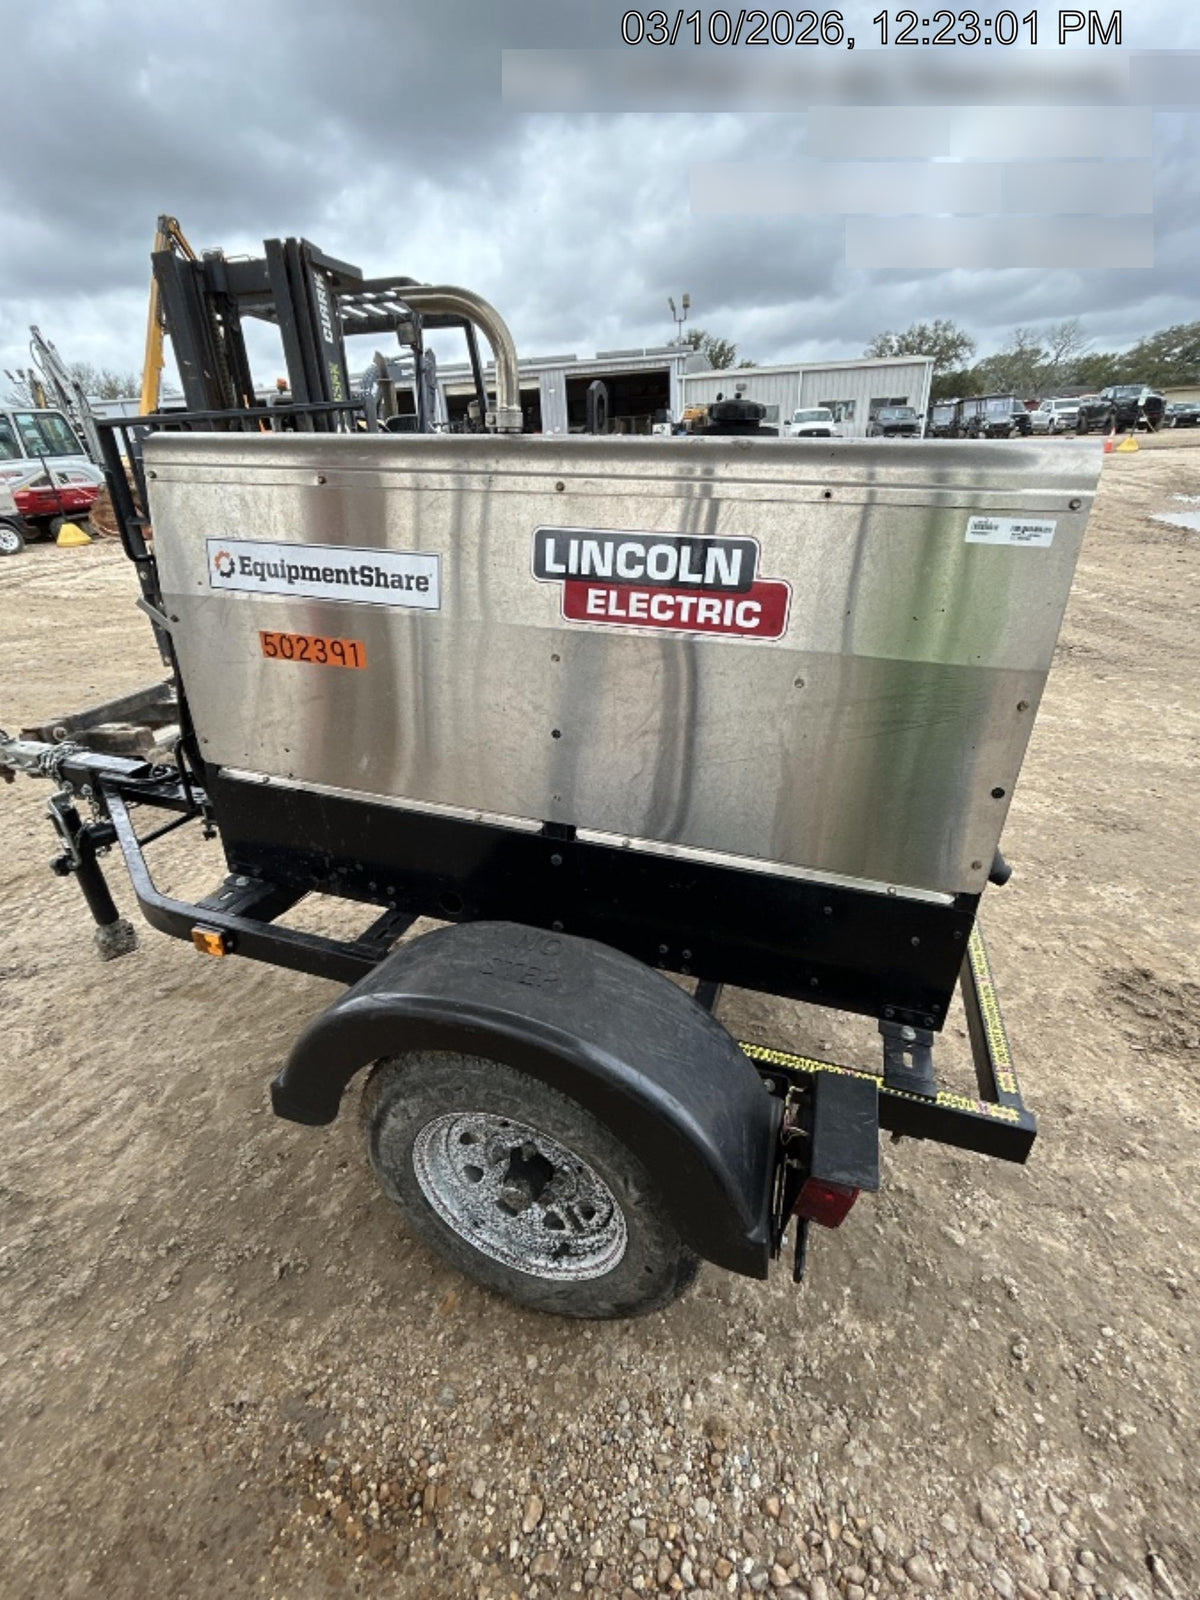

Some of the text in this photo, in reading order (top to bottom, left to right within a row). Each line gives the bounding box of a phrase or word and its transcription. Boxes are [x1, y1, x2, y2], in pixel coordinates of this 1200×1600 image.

[314, 271, 333, 344] CLARK
[238, 555, 429, 592] EquipmentShare
[544, 538, 743, 586] LINCOLN
[586, 588, 762, 628] ELECTRIC
[263, 634, 360, 668] 502391
